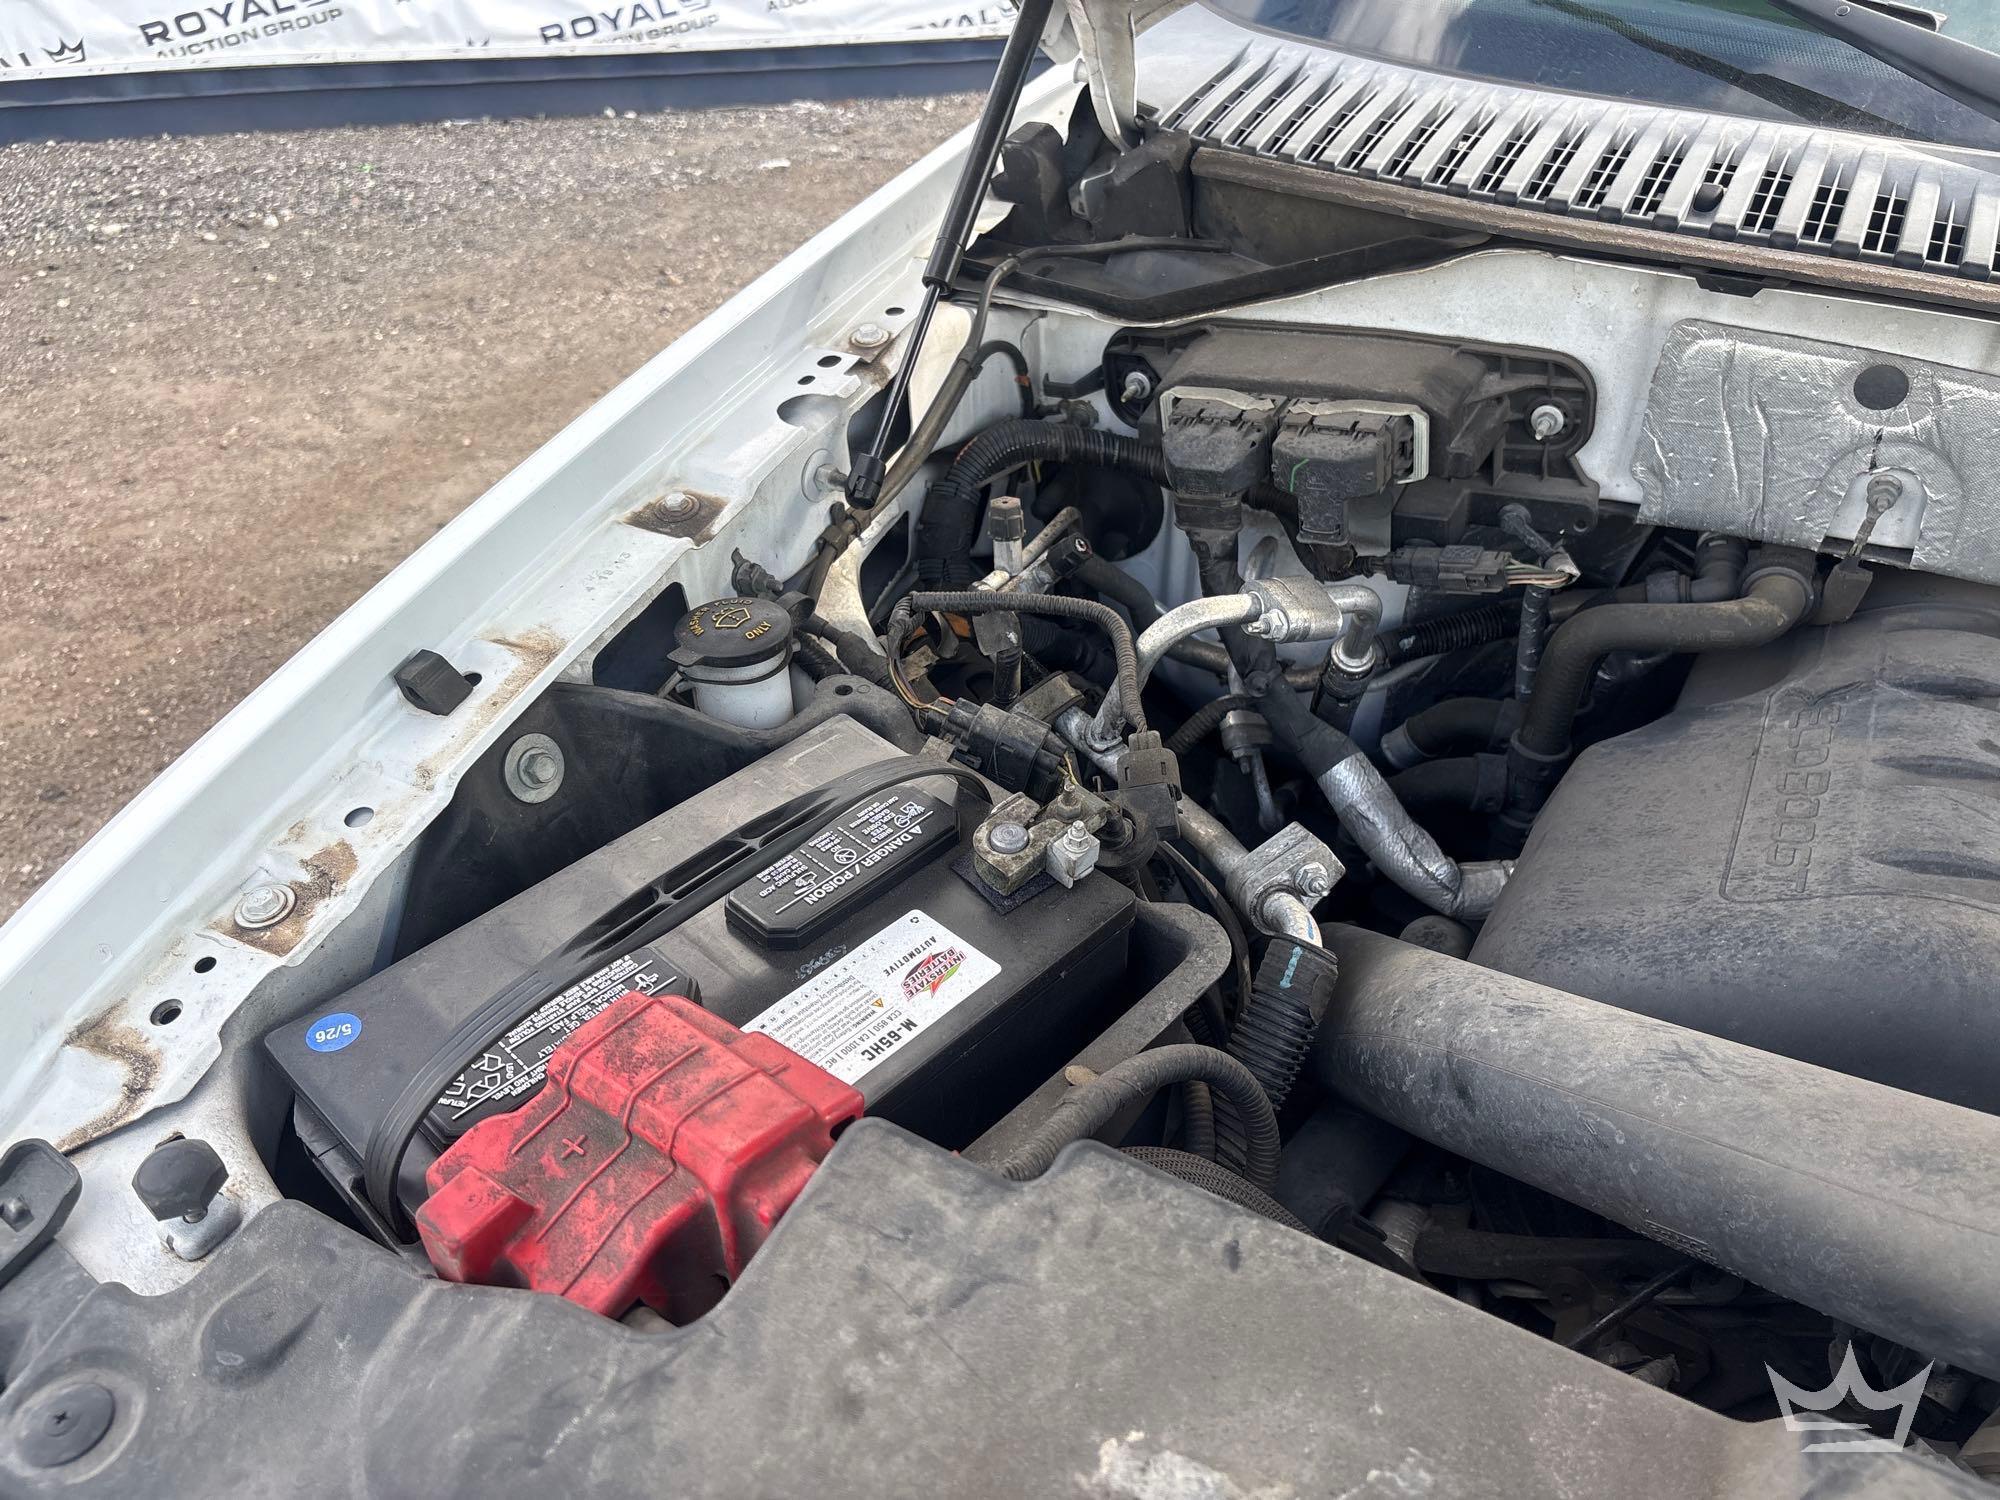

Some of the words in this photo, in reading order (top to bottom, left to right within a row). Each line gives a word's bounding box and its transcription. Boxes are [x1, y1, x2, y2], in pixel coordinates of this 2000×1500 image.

[156, 27, 260, 58] AUCTION
[262, 8, 345, 37] GROUP
[539, 0, 678, 45] ROYAL
[646, 14, 720, 39] GROUP
[689, 606, 710, 637] WASHER
[714, 599, 754, 607] FLUID
[745, 620, 772, 640] ONLY
[860, 811, 896, 835] EXPLOSIVE
[869, 823, 888, 836] EYES
[869, 827, 894, 843] SHIELD
[829, 844, 841, 852] NO
[859, 831, 913, 868] DANGER
[773, 863, 808, 887] SULFURIC
[758, 883, 777, 897] ACID
[802, 870, 854, 905] POISON
[882, 935, 937, 976] AUTOMOTIVE
[901, 948, 955, 988] BATTERIES
[905, 952, 964, 998] INTERSTATE
[589, 983, 625, 1006] MEDICAL
[567, 1004, 592, 1020] HELP
[885, 1009, 902, 1022] CCA
[314, 1023, 353, 1043] 5/26
[546, 1017, 570, 1033] FAST
[561, 1019, 581, 1033] GET
[871, 1019, 888, 1031] 850
[839, 1040, 860, 1055] 1000
[856, 1032, 870, 1042] CA
[859, 1017, 918, 1061] M-65HC
[509, 1072, 546, 1096] CHILDREN
[512, 1074, 529, 1086] AND
[490, 1084, 514, 1100] LEVEL
